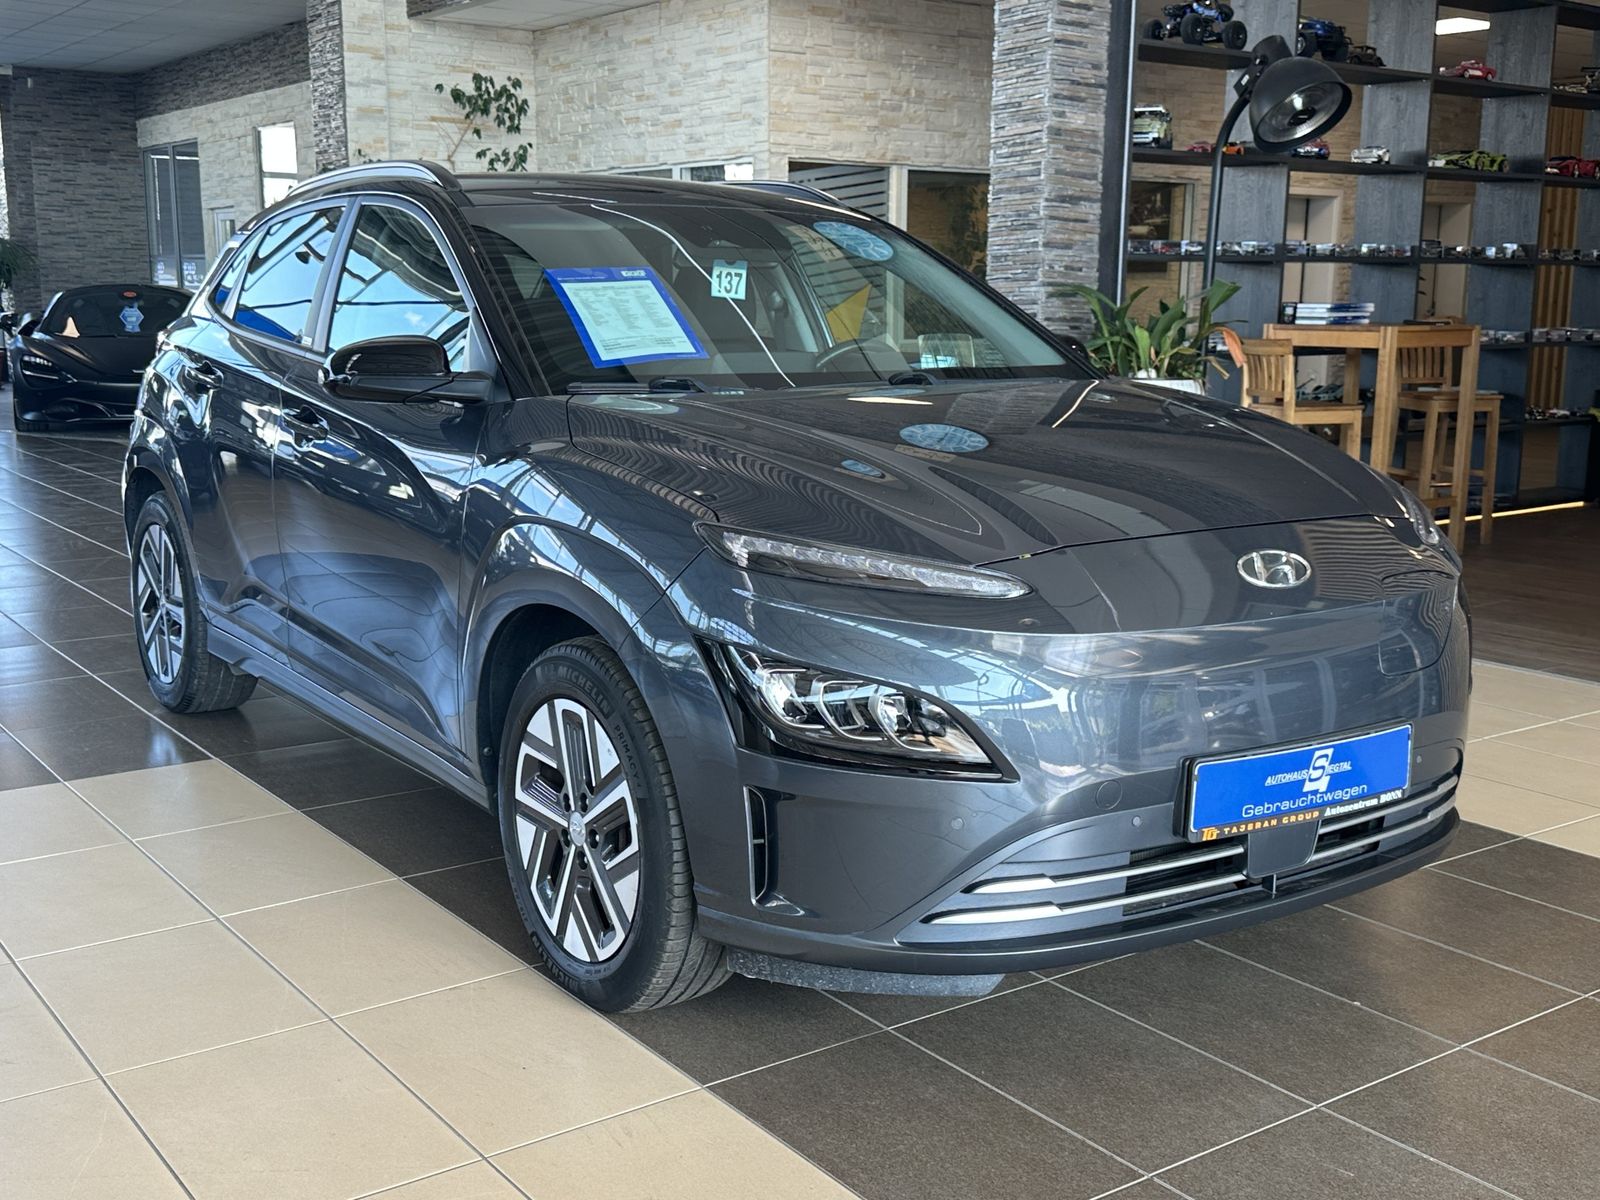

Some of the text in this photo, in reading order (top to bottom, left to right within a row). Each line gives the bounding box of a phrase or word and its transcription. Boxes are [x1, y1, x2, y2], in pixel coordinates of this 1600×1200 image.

[716, 270, 743, 295] 137
[557, 665, 611, 714] MICHELIN
[614, 724, 640, 780] PRIMACY
[1264, 769, 1308, 787] AUTOHAUS
[1241, 784, 1368, 818] Gebrauchtwagen
[1281, 811, 1320, 824] GROUP
